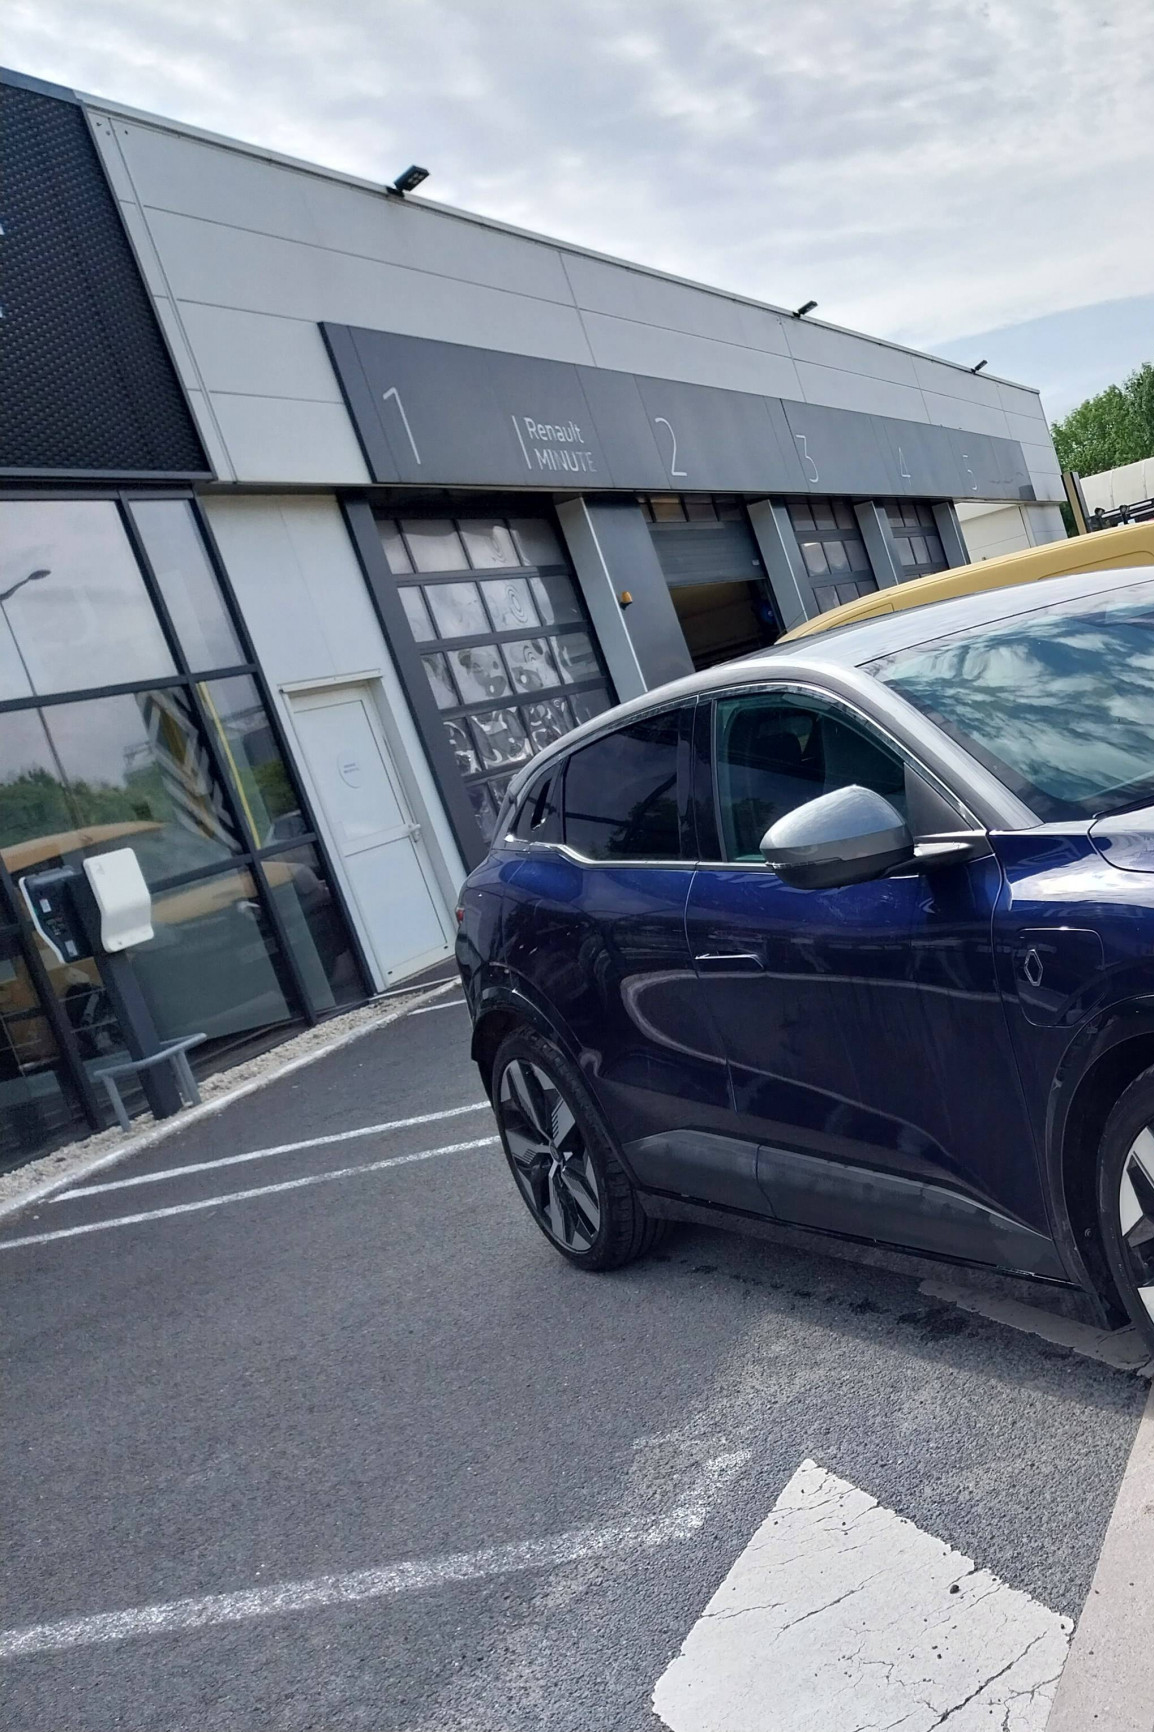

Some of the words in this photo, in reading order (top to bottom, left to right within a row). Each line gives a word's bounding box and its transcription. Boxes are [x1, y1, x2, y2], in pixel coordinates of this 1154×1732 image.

[382, 386, 422, 466] 1
[524, 416, 585, 444] Renault
[654, 416, 688, 477] 2
[534, 448, 598, 473] MINUTE
[795, 433, 820, 484] 3
[898, 446, 913, 488] 4
[962, 453, 978, 492] 5
